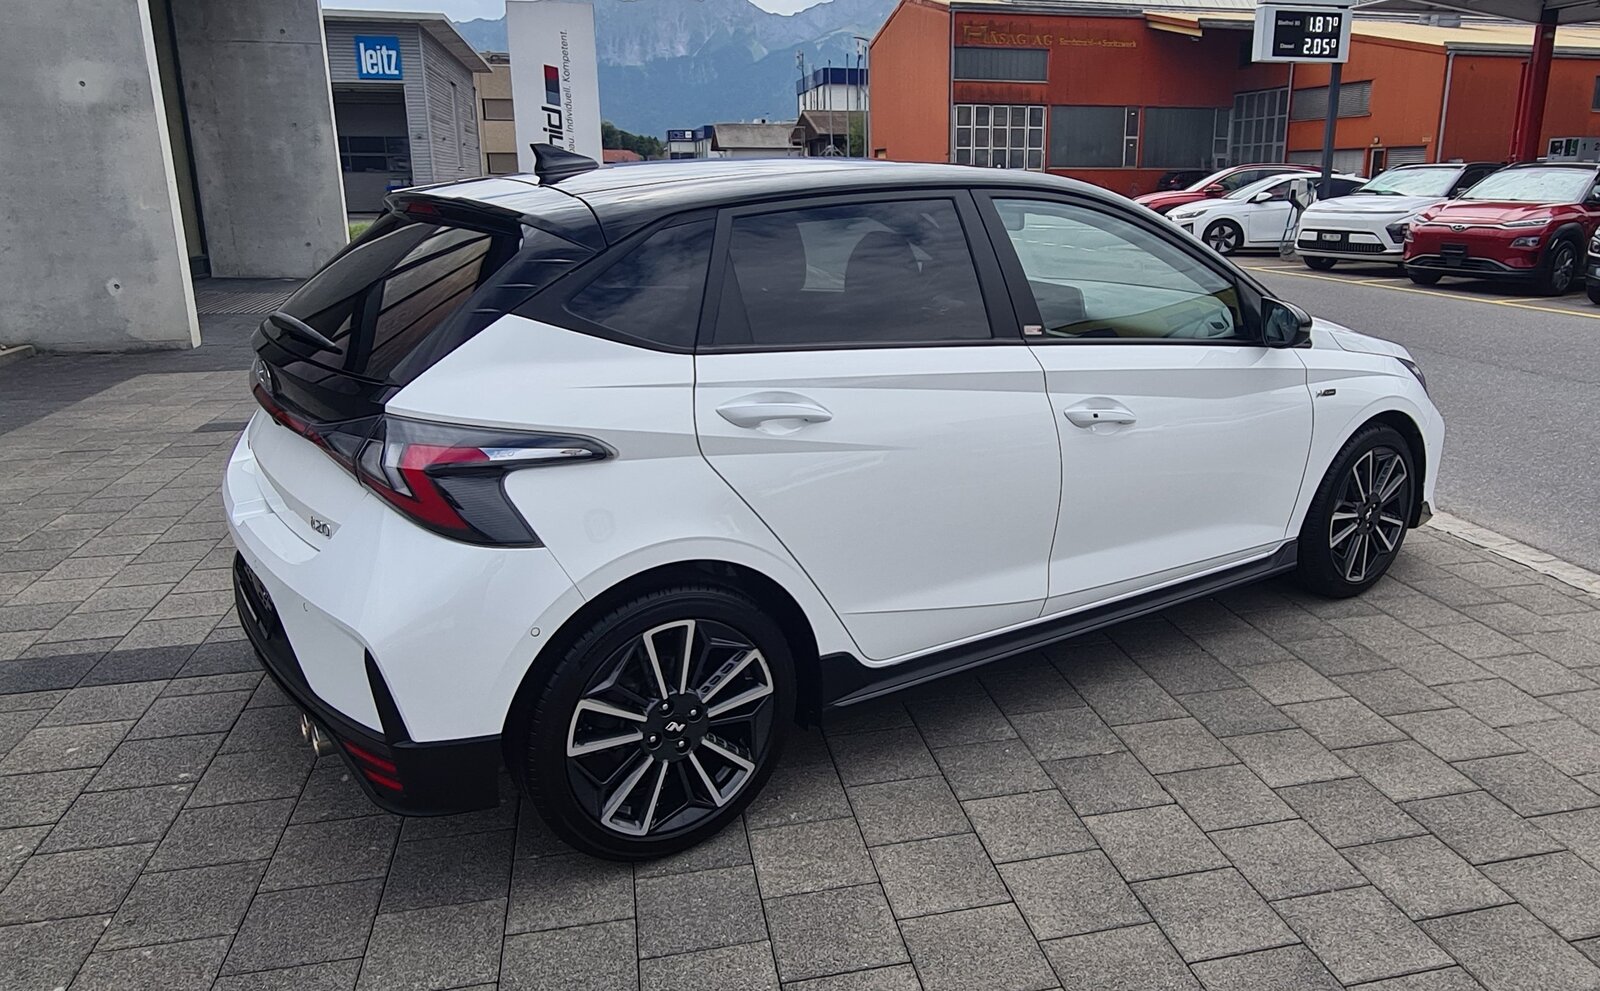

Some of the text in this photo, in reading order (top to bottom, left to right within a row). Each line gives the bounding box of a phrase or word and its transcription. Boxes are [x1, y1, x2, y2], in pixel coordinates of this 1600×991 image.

[359, 42, 400, 75] leitz
[560, 29, 571, 82] Kompetent.
[563, 86, 574, 133] Individuell.
